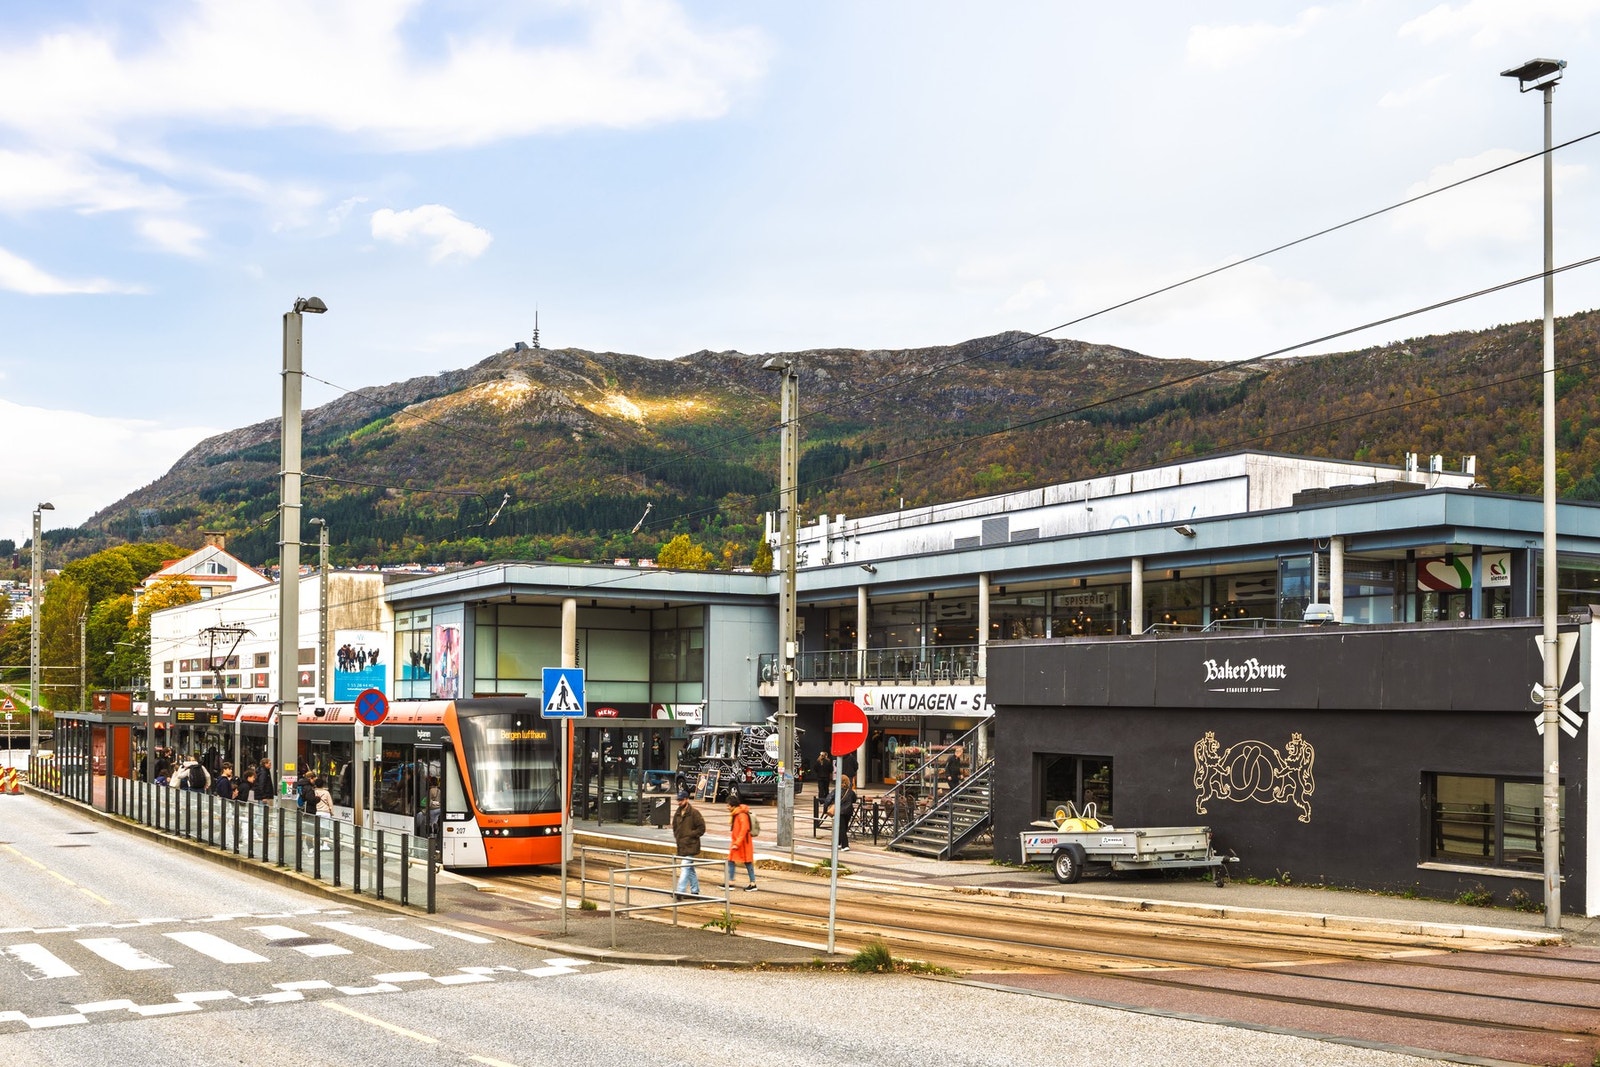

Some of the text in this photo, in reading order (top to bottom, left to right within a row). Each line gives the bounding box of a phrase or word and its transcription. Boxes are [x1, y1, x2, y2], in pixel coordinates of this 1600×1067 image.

[1065, 594, 1109, 606] SPISERIET
[1203, 658, 1287, 682] BakerBrun
[880, 693, 906, 710] NYT
[908, 693, 957, 711] DAGEN
[500, 729, 522, 740] Bergen
